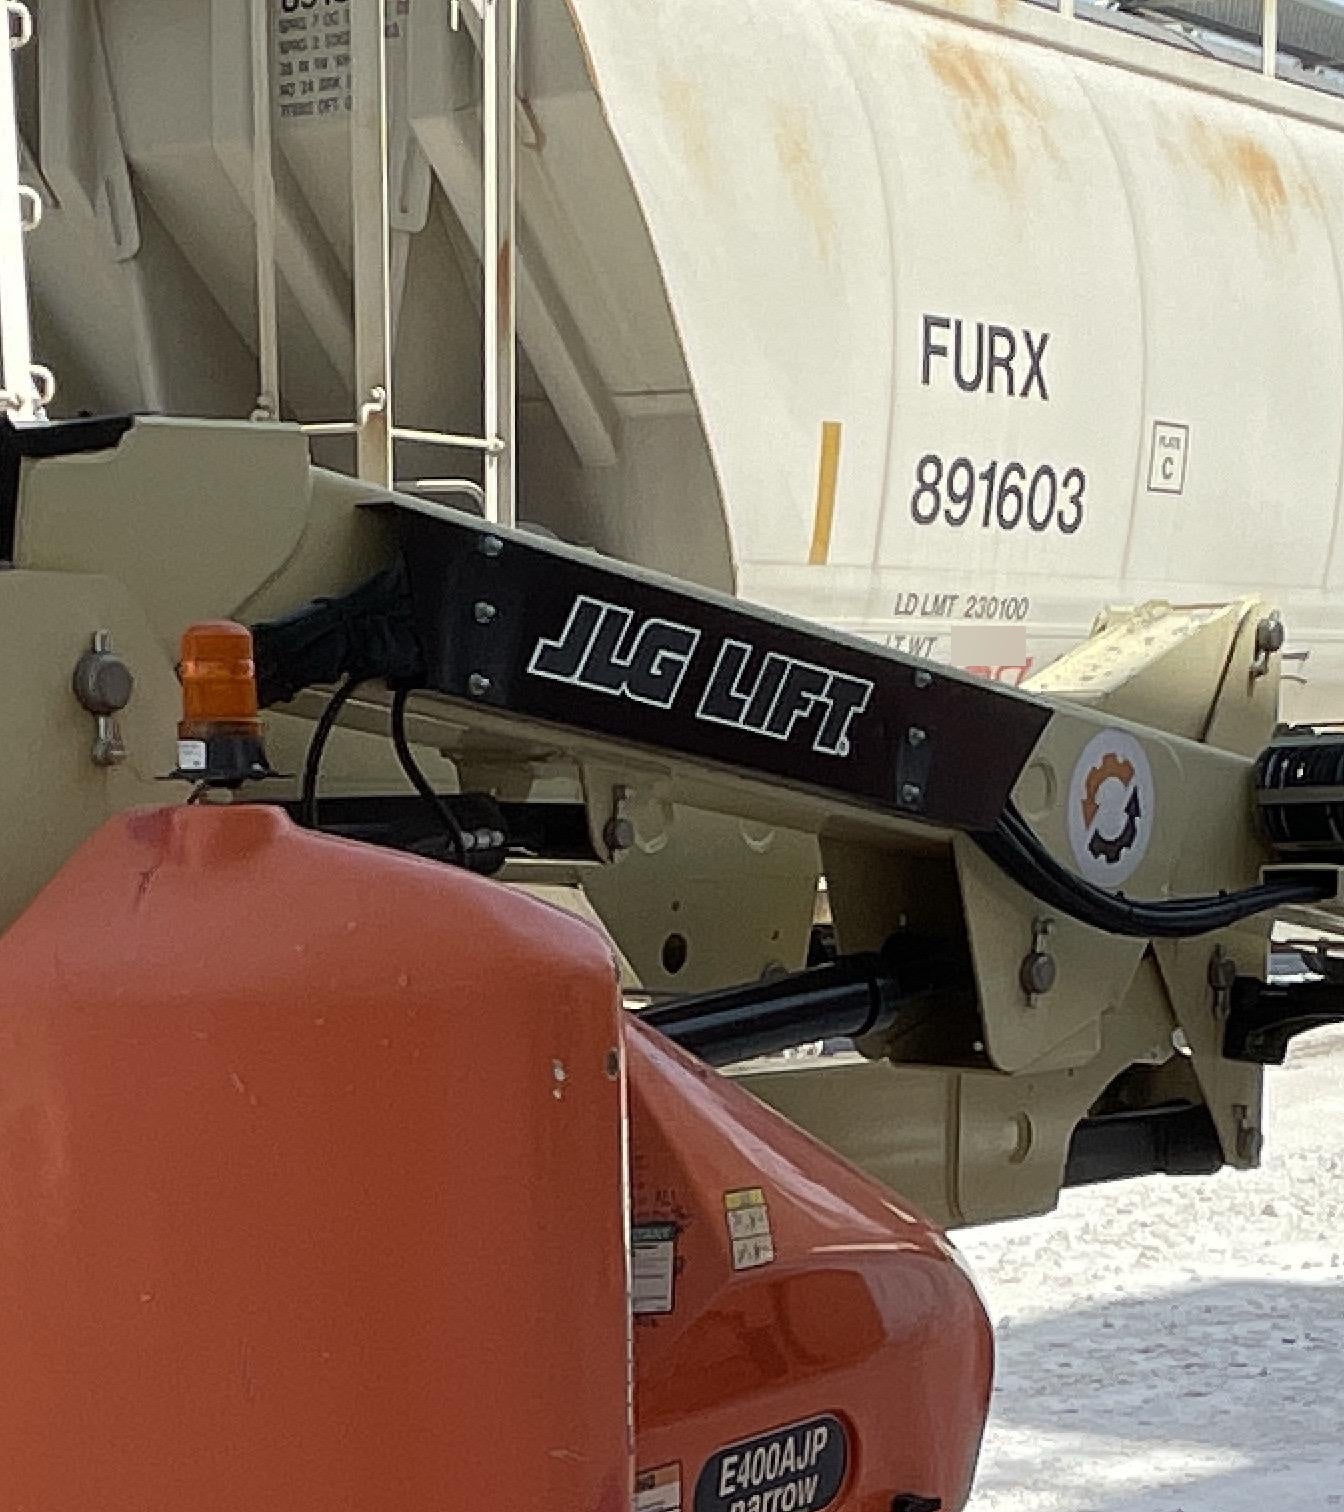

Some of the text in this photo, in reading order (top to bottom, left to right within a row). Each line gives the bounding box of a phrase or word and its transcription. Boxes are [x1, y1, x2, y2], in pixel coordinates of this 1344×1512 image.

[920, 313, 1051, 401] FURX
[909, 453, 1087, 535] 891603
[1161, 456, 1174, 480] C
[894, 592, 1030, 620] LD LMT 230100
[526, 594, 875, 757] JLG LIFT
[718, 1424, 830, 1498] E400AJP
